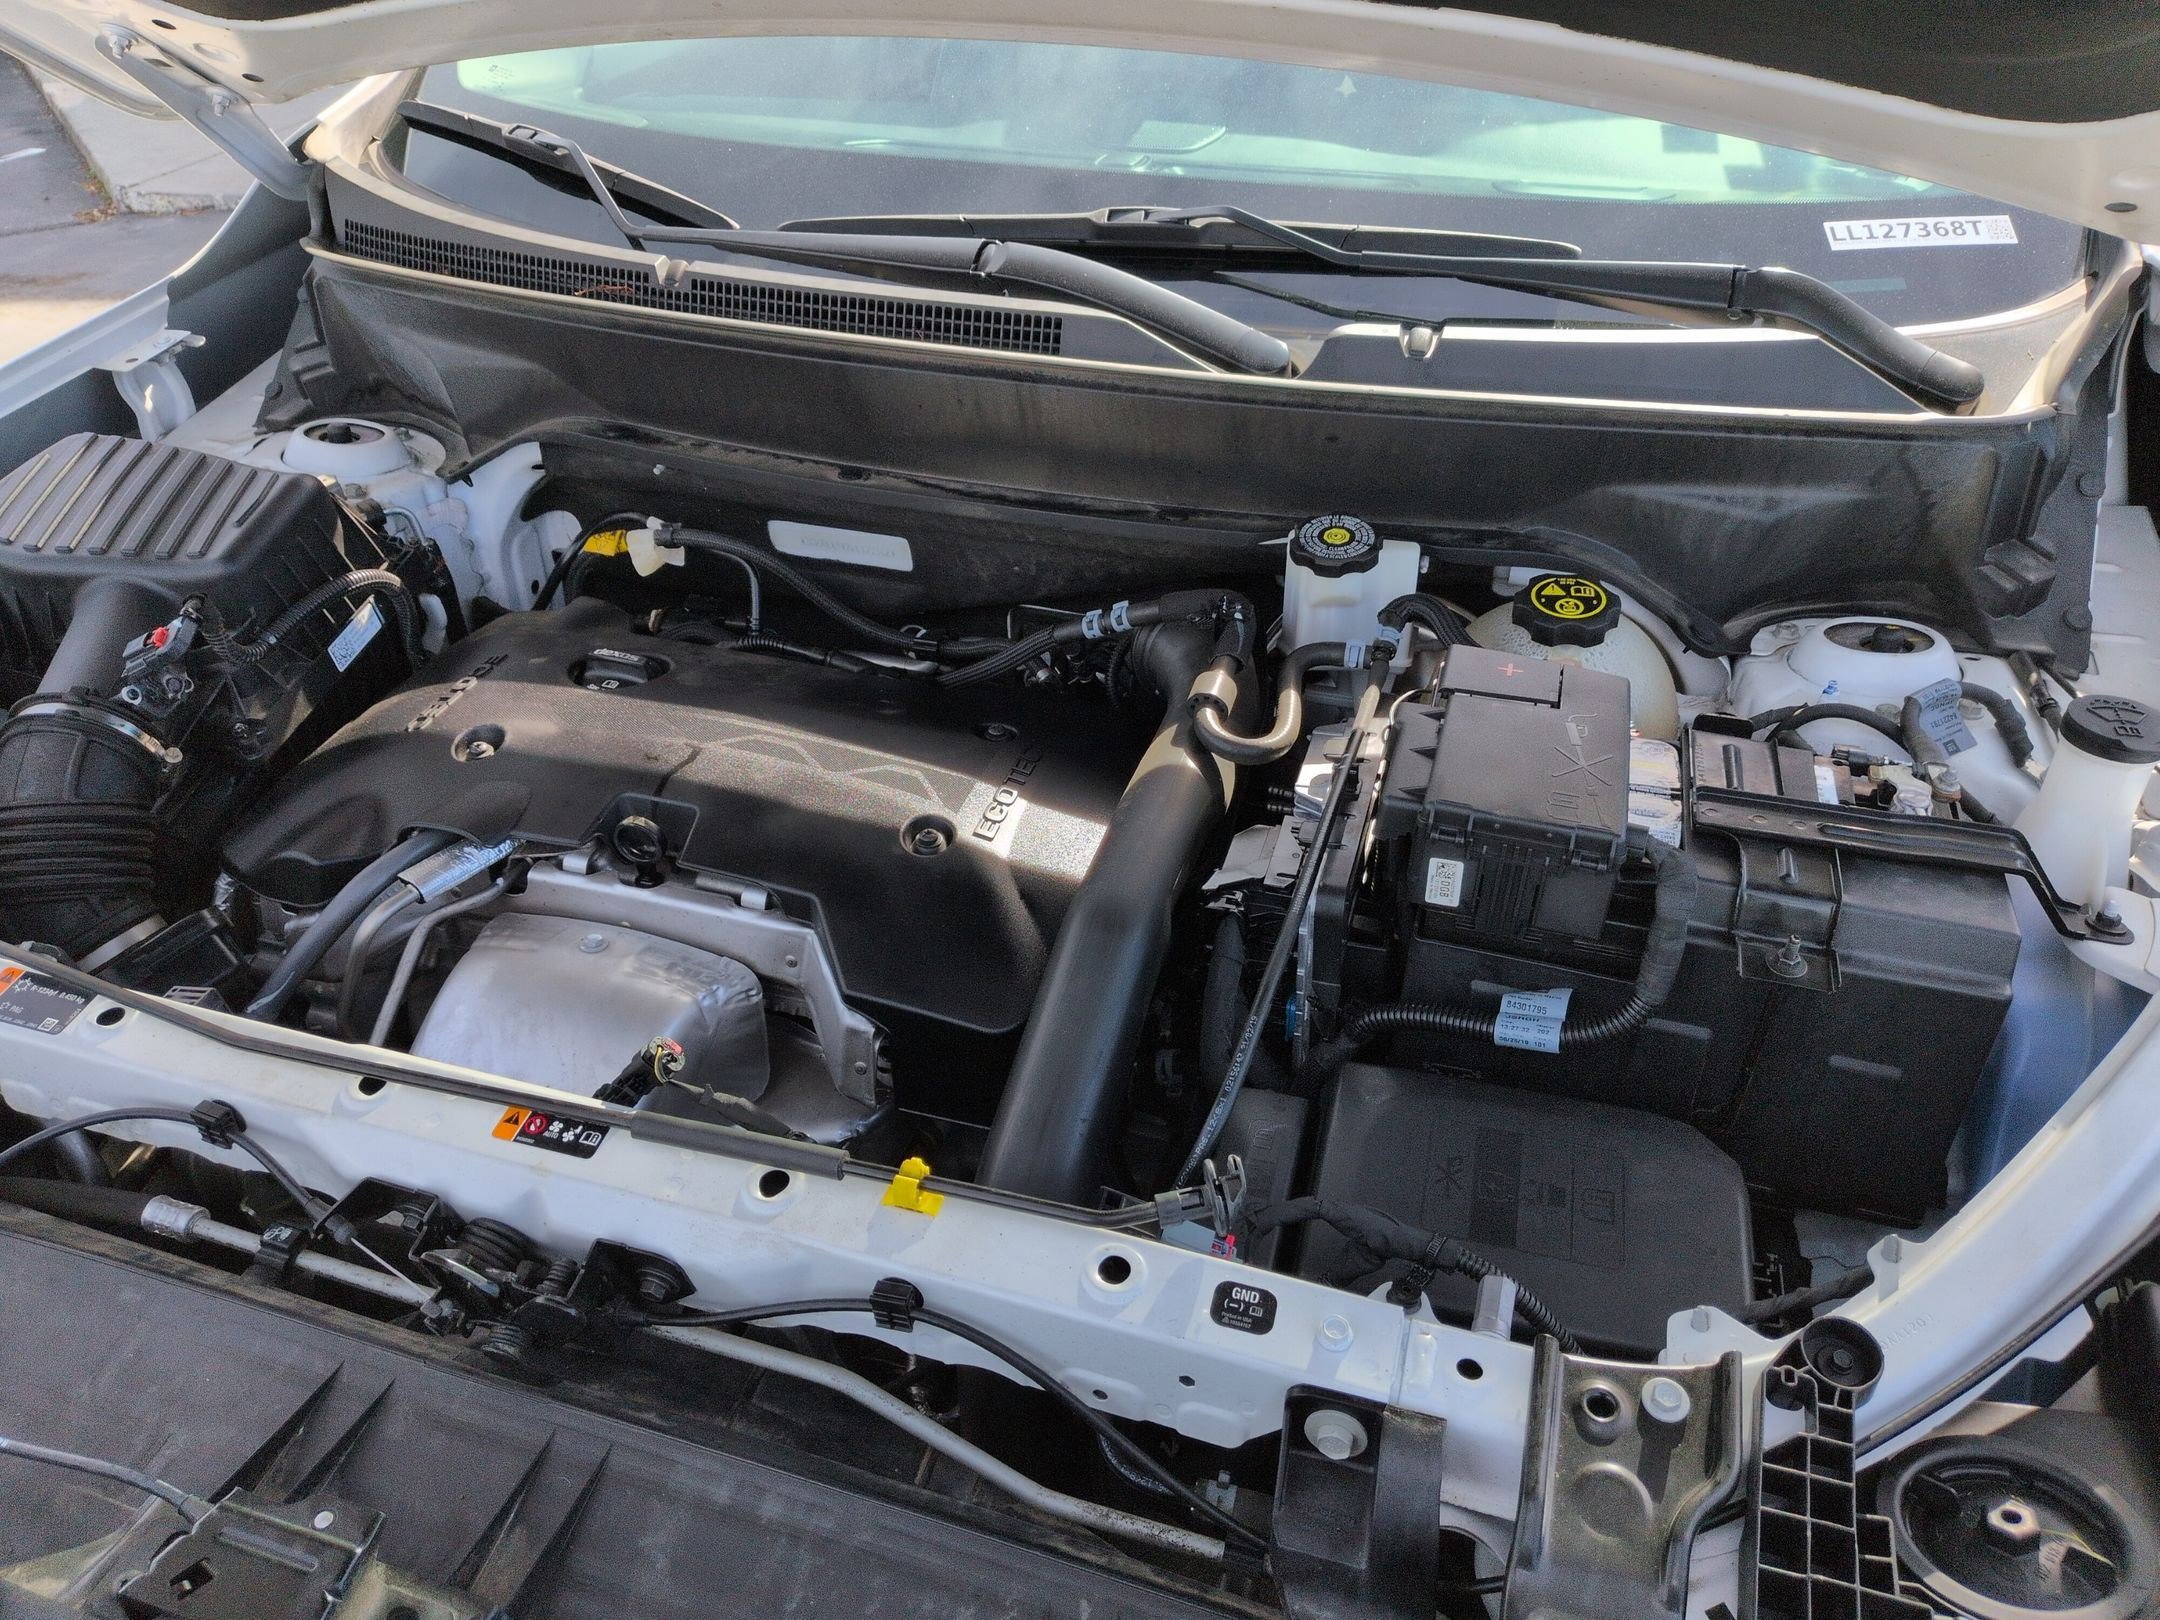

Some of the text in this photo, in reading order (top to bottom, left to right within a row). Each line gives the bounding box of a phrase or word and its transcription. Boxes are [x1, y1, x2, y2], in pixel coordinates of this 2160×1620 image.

[1829, 220, 1982, 242] LL127368T
[972, 743, 1042, 842] ECOTEC
[1506, 1000, 1548, 1015] 84301795
[543, 1130, 559, 1139] AUTO
